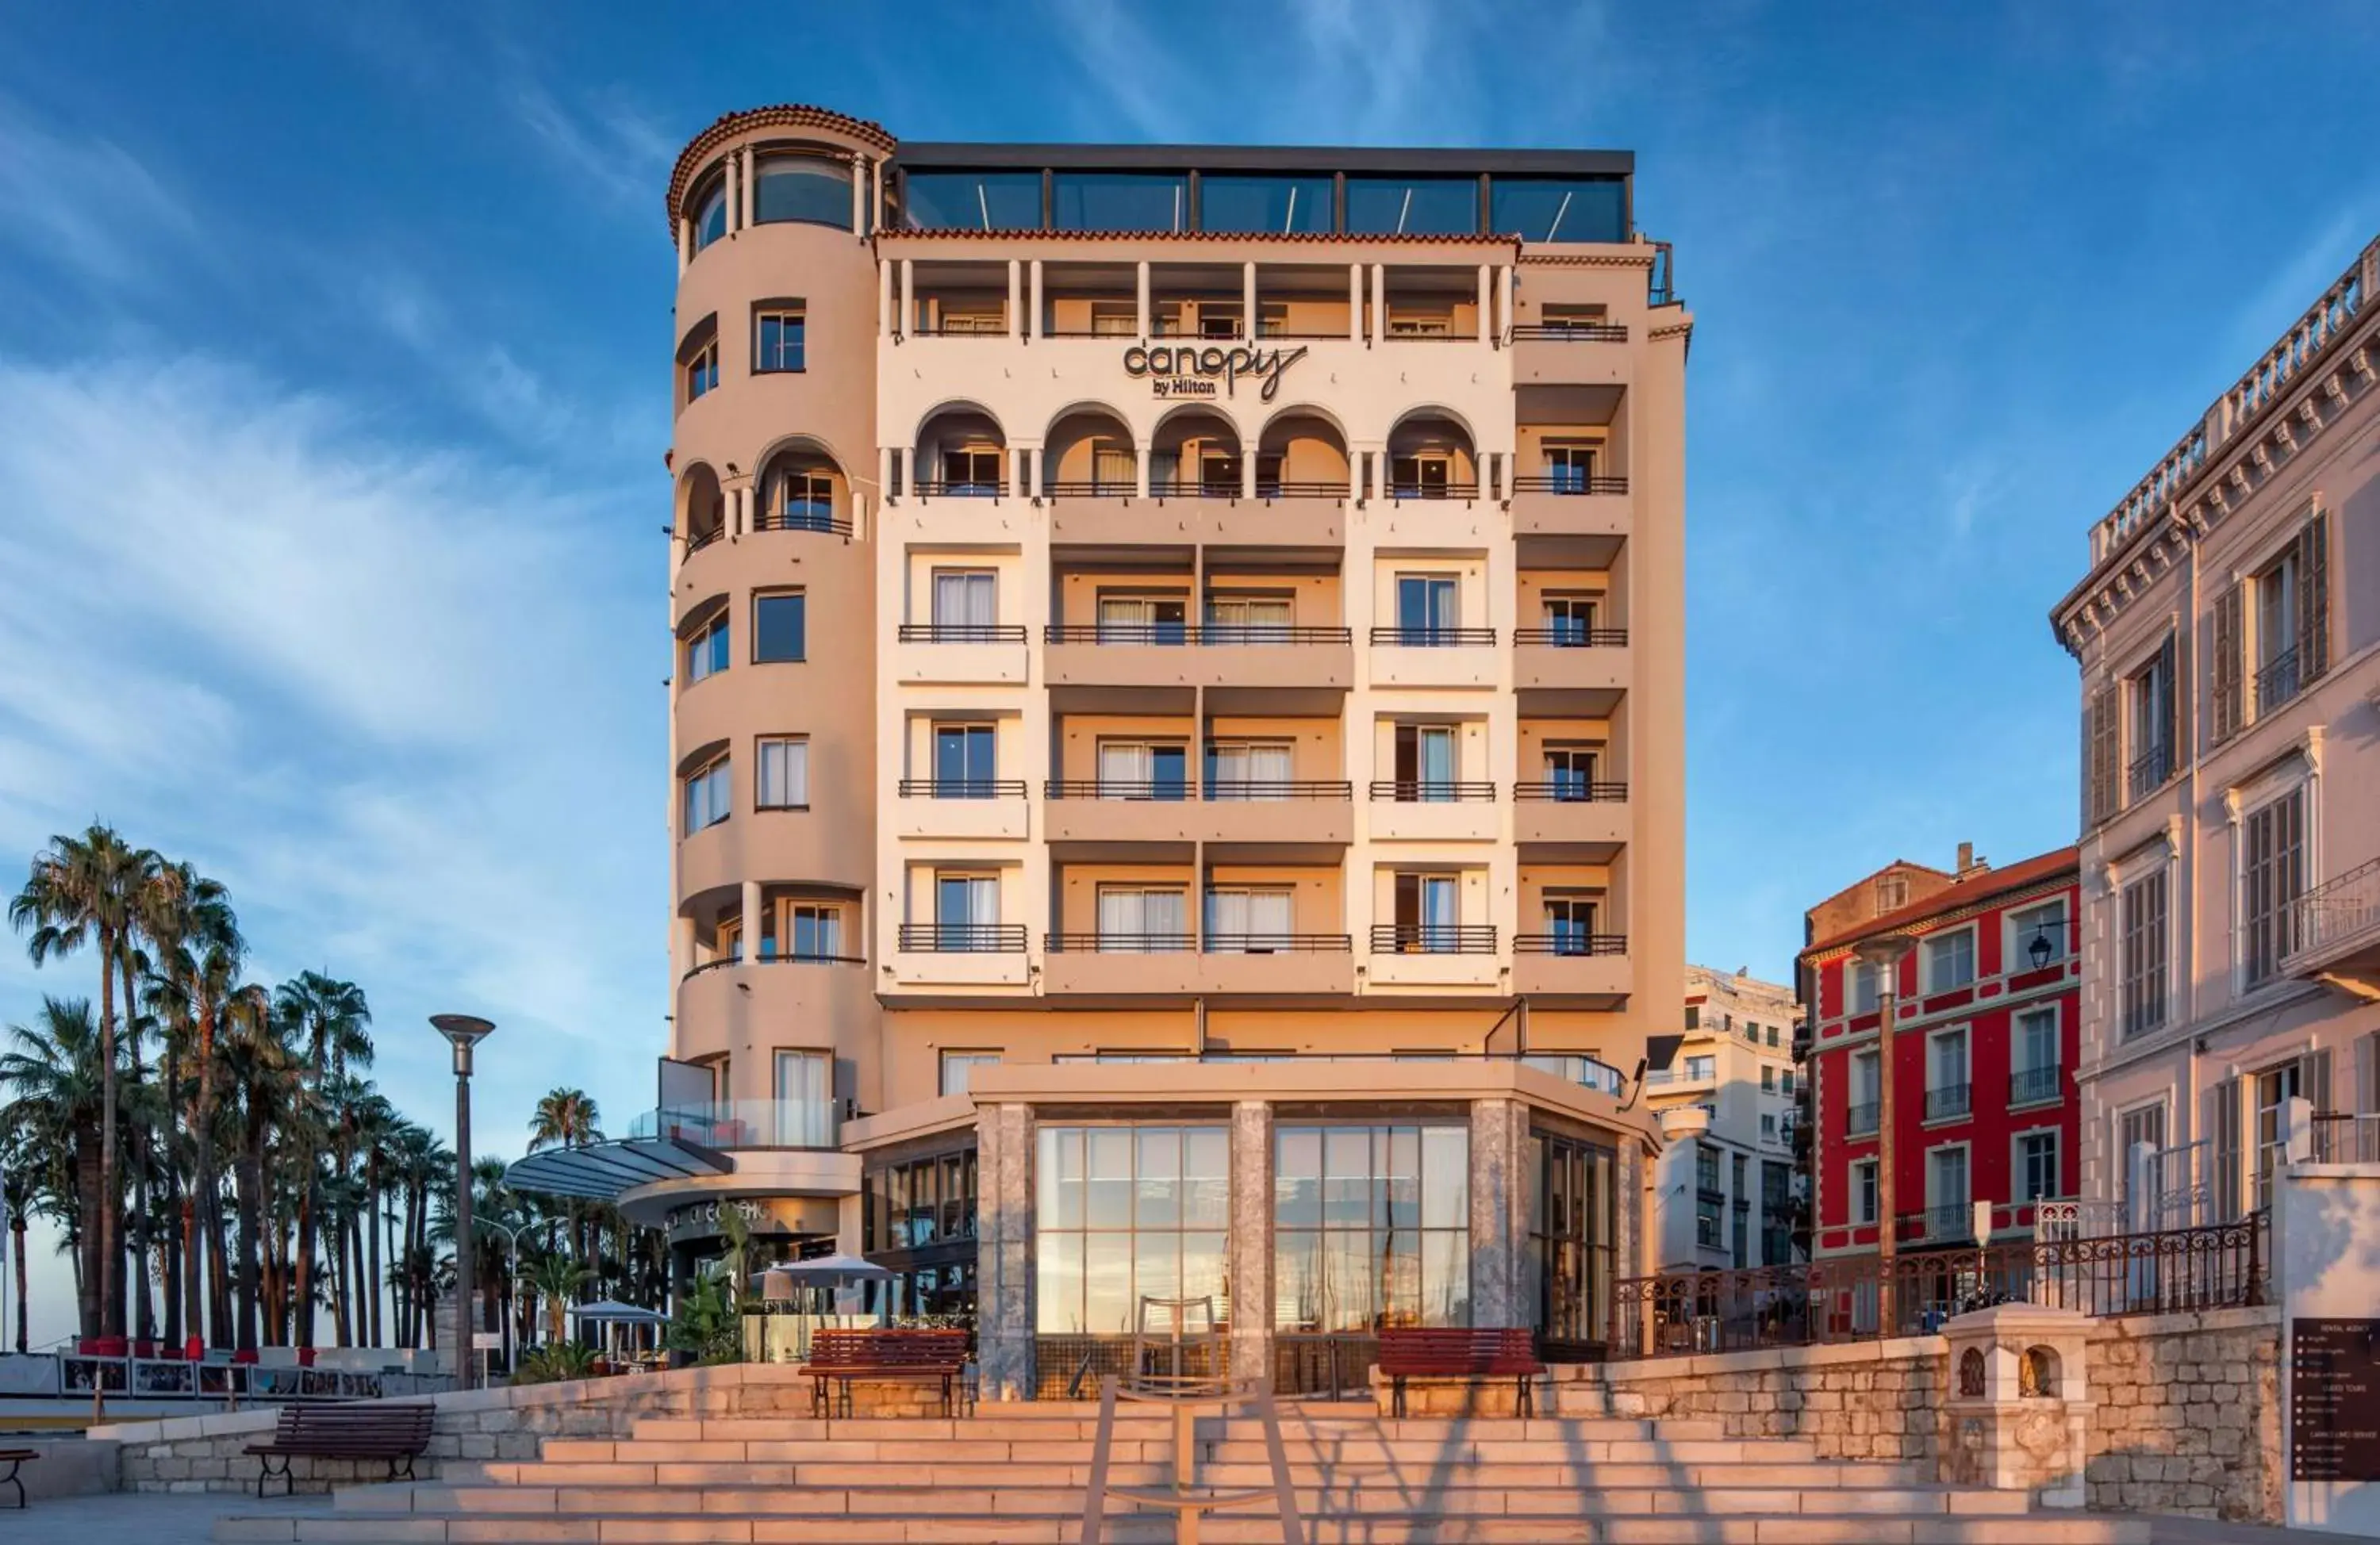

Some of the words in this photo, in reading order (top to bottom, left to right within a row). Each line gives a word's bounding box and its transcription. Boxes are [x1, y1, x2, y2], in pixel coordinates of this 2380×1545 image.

[1123, 345, 1307, 401] canopy
[1153, 379, 1169, 396] by
[1172, 379, 1216, 394] Hilton
